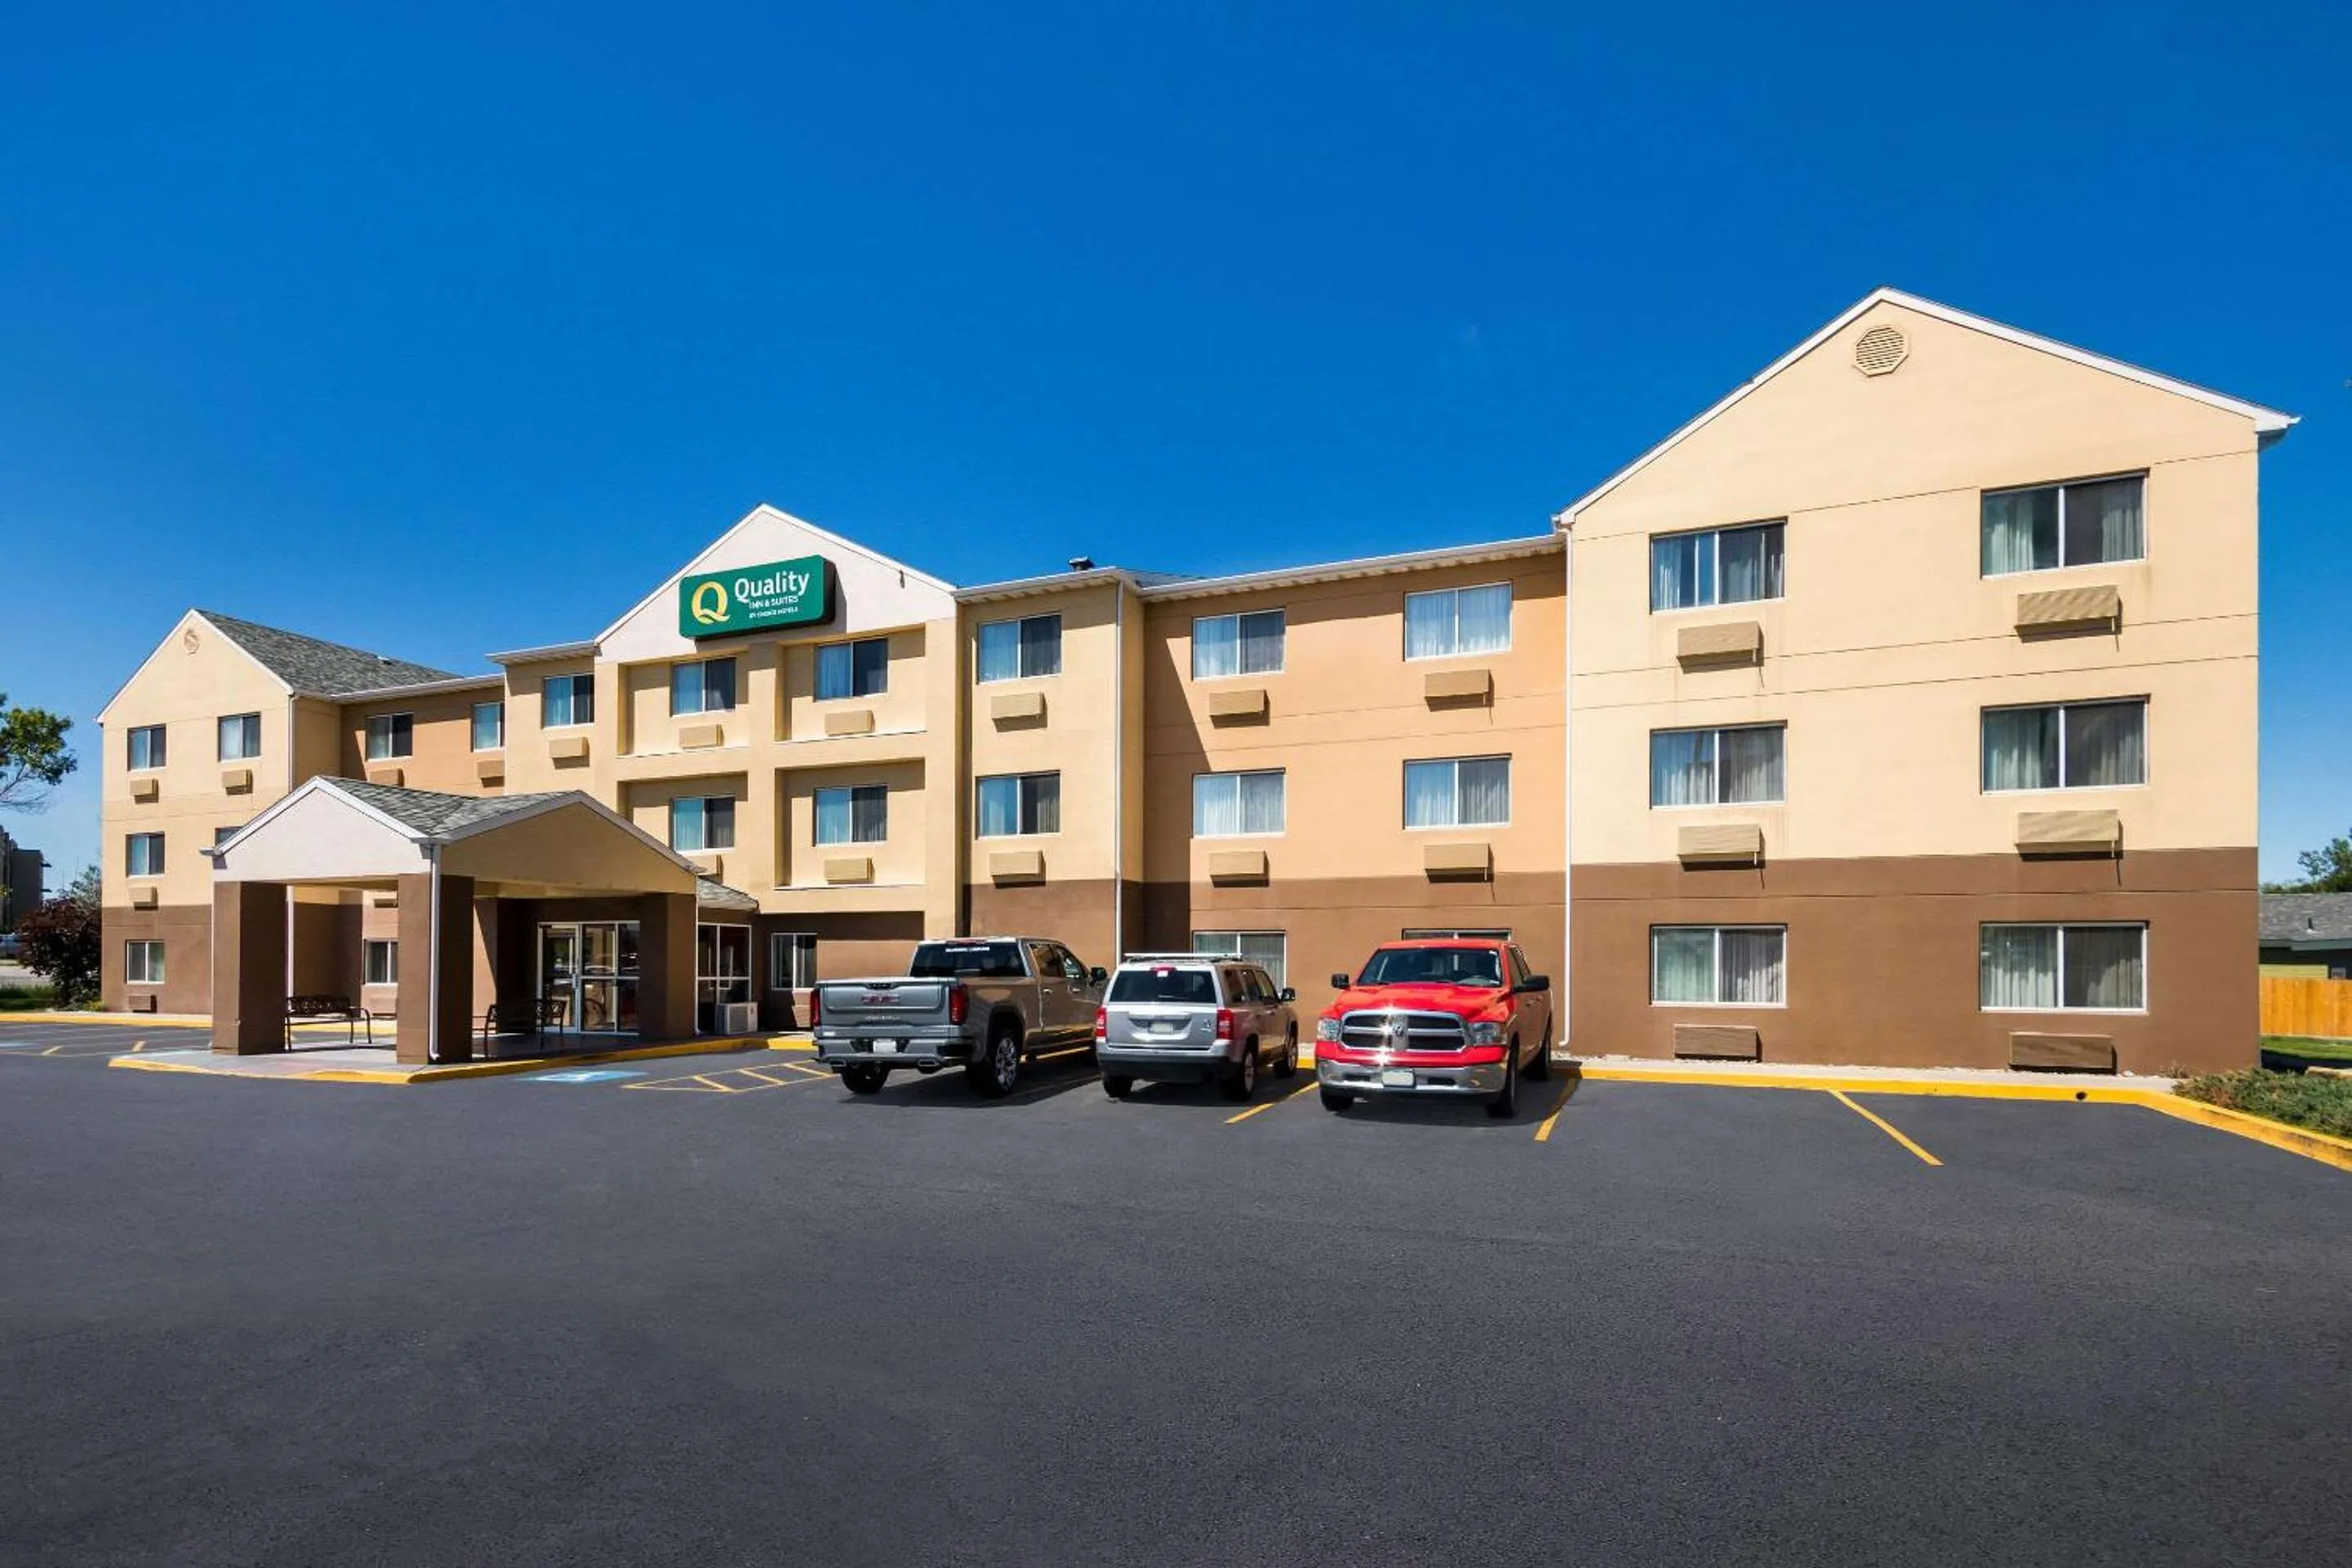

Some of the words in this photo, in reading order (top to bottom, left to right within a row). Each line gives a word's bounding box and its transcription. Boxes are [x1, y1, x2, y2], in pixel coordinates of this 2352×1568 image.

[691, 581, 731, 624] Q
[734, 570, 809, 603] Quality
[749, 599, 764, 609] INN
[771, 595, 799, 606] SUITES
